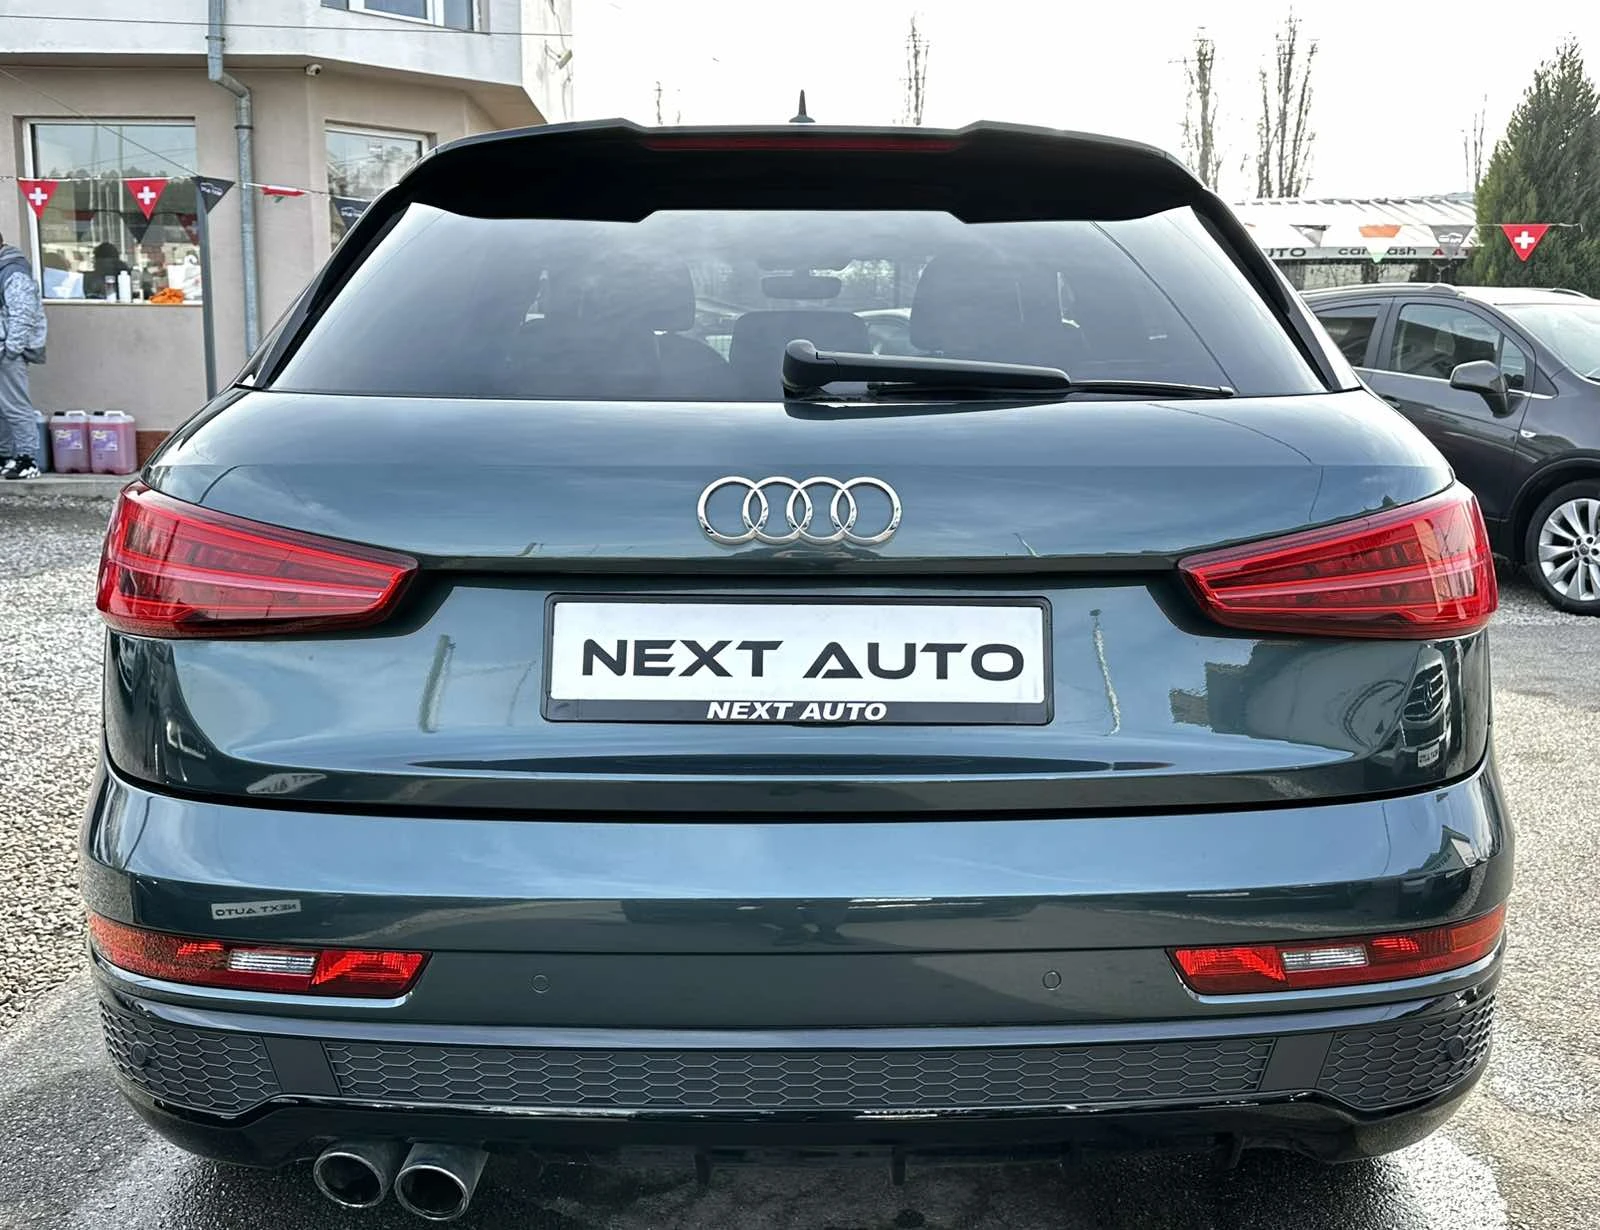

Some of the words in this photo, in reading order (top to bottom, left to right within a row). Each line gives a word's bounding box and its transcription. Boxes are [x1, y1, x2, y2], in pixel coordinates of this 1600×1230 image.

[582, 638, 784, 677] NEXT
[802, 641, 1024, 681] AUTO
[706, 701, 793, 720] NEXT
[799, 702, 887, 721] AUTO
